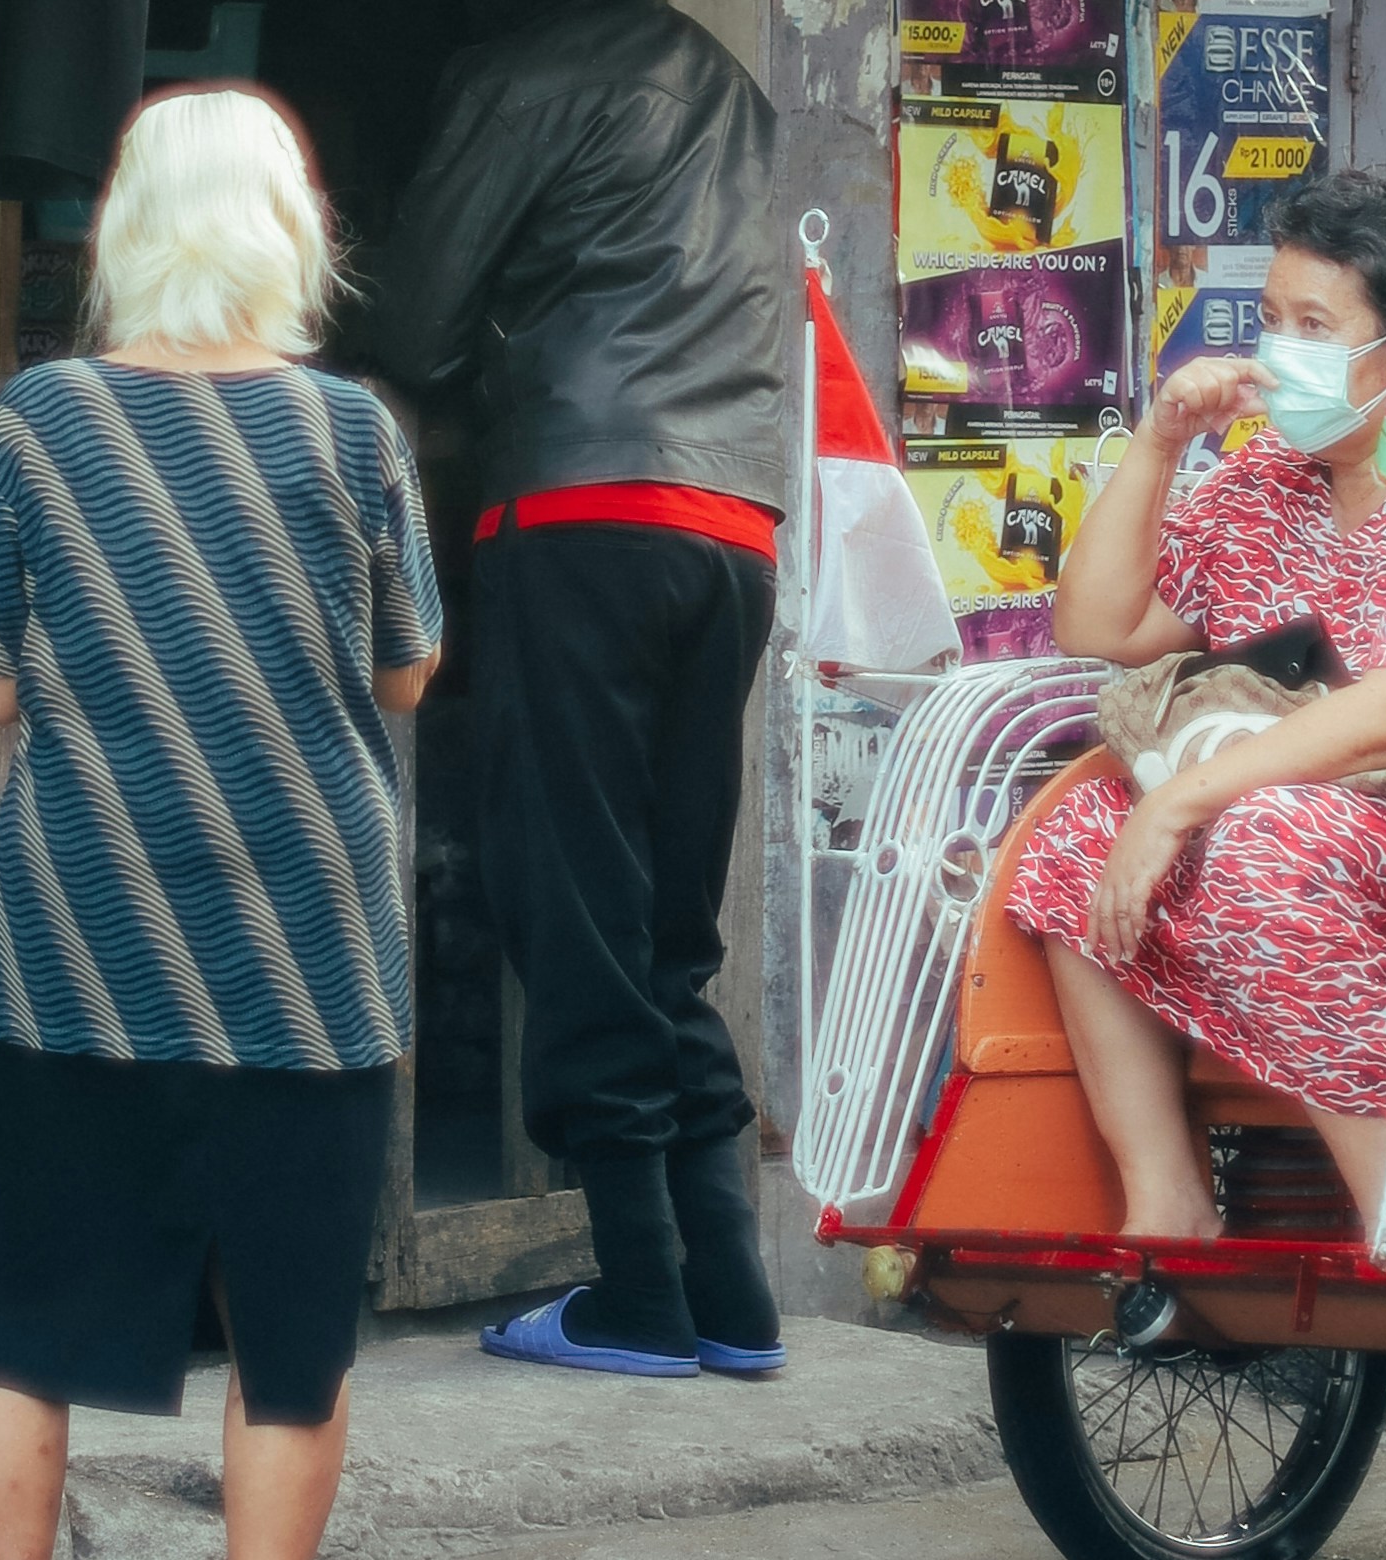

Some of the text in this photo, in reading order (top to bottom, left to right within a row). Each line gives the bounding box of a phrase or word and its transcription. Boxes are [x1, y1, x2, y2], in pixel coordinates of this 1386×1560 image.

[1160, 16, 1186, 64] NEW
[1240, 27, 1315, 73] ESSE
[1222, 78, 1314, 112] CHANGE
[902, 105, 992, 120] NEW MILD CAPSULE
[996, 170, 1047, 195] CAMEL
[1164, 130, 1225, 238] 16
[1228, 187, 1237, 237] STICKS
[913, 251, 965, 269] WHICH
[968, 253, 1002, 268] SIDE
[1001, 253, 1033, 269] ARE
[1035, 254, 1070, 271] YOU
[1072, 255, 1096, 271] ON
[1159, 291, 1184, 340] NEW
[978, 325, 1023, 347] CAMEL
[907, 449, 1000, 462] NEW MILD CAPSULE
[1006, 508, 1053, 532] CAMEL
[976, 595, 1008, 611] SIDE
[1011, 594, 1042, 610] ARE
